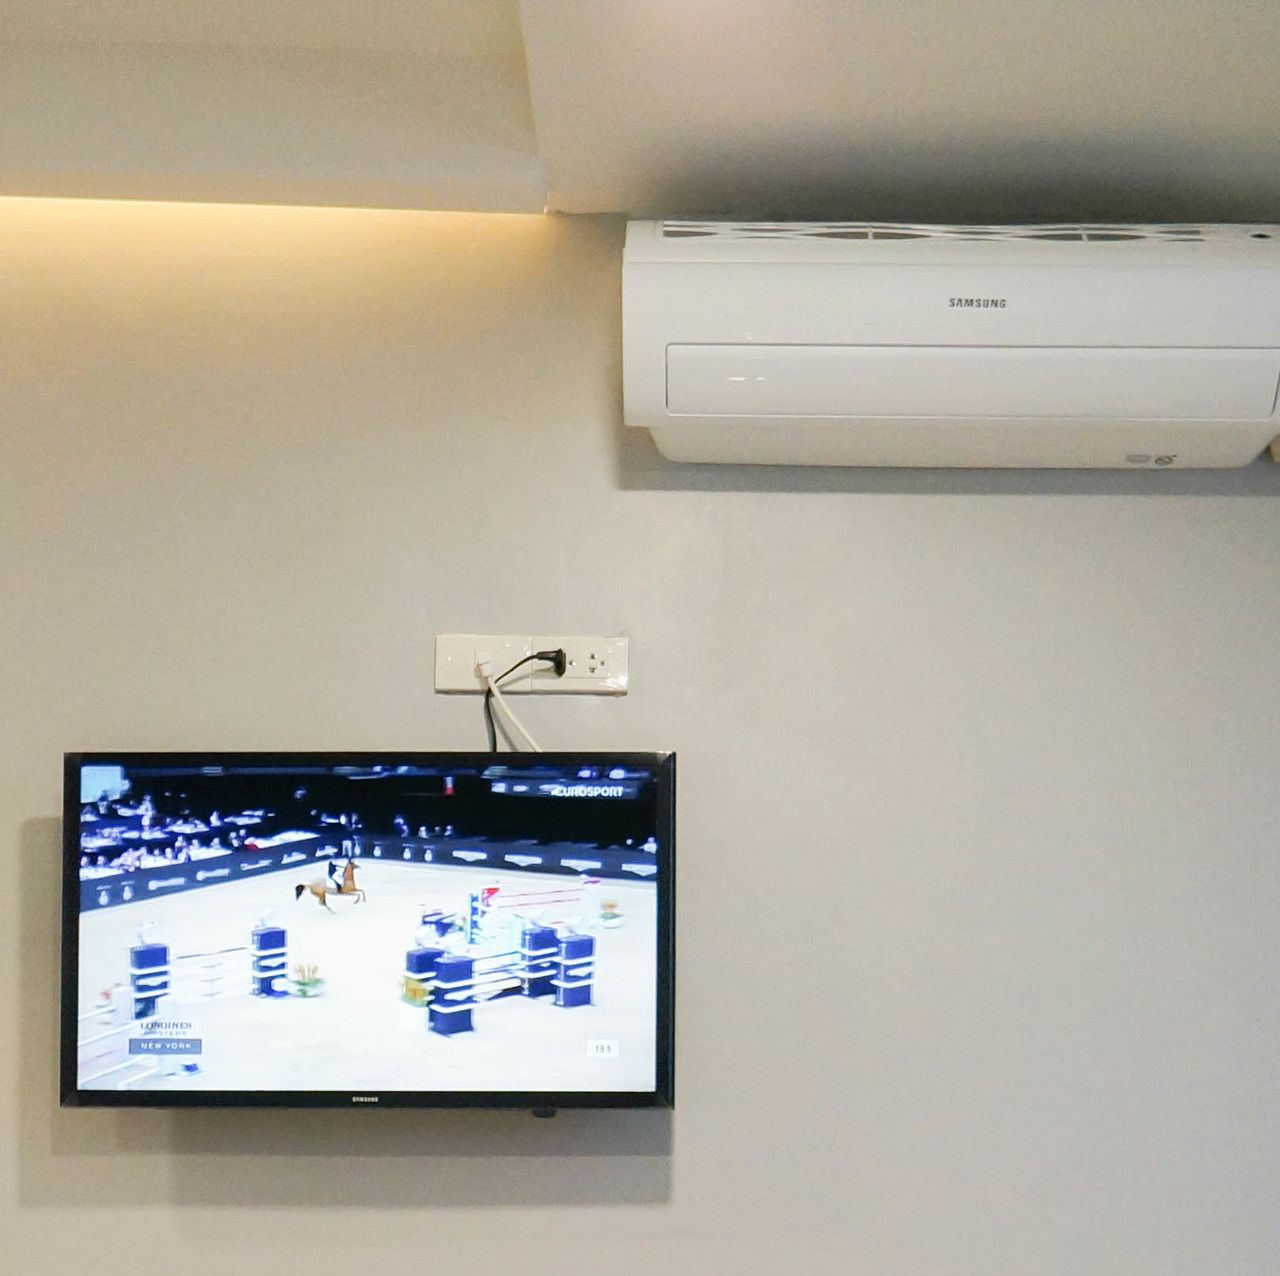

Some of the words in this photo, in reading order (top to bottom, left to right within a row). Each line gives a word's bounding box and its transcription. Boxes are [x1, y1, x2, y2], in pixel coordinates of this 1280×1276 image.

[948, 298, 1006, 308] SAMSUNG
[557, 786, 623, 797] EUROSPORT
[140, 1042, 163, 1050] NEW
[165, 1042, 192, 1050] YORK
